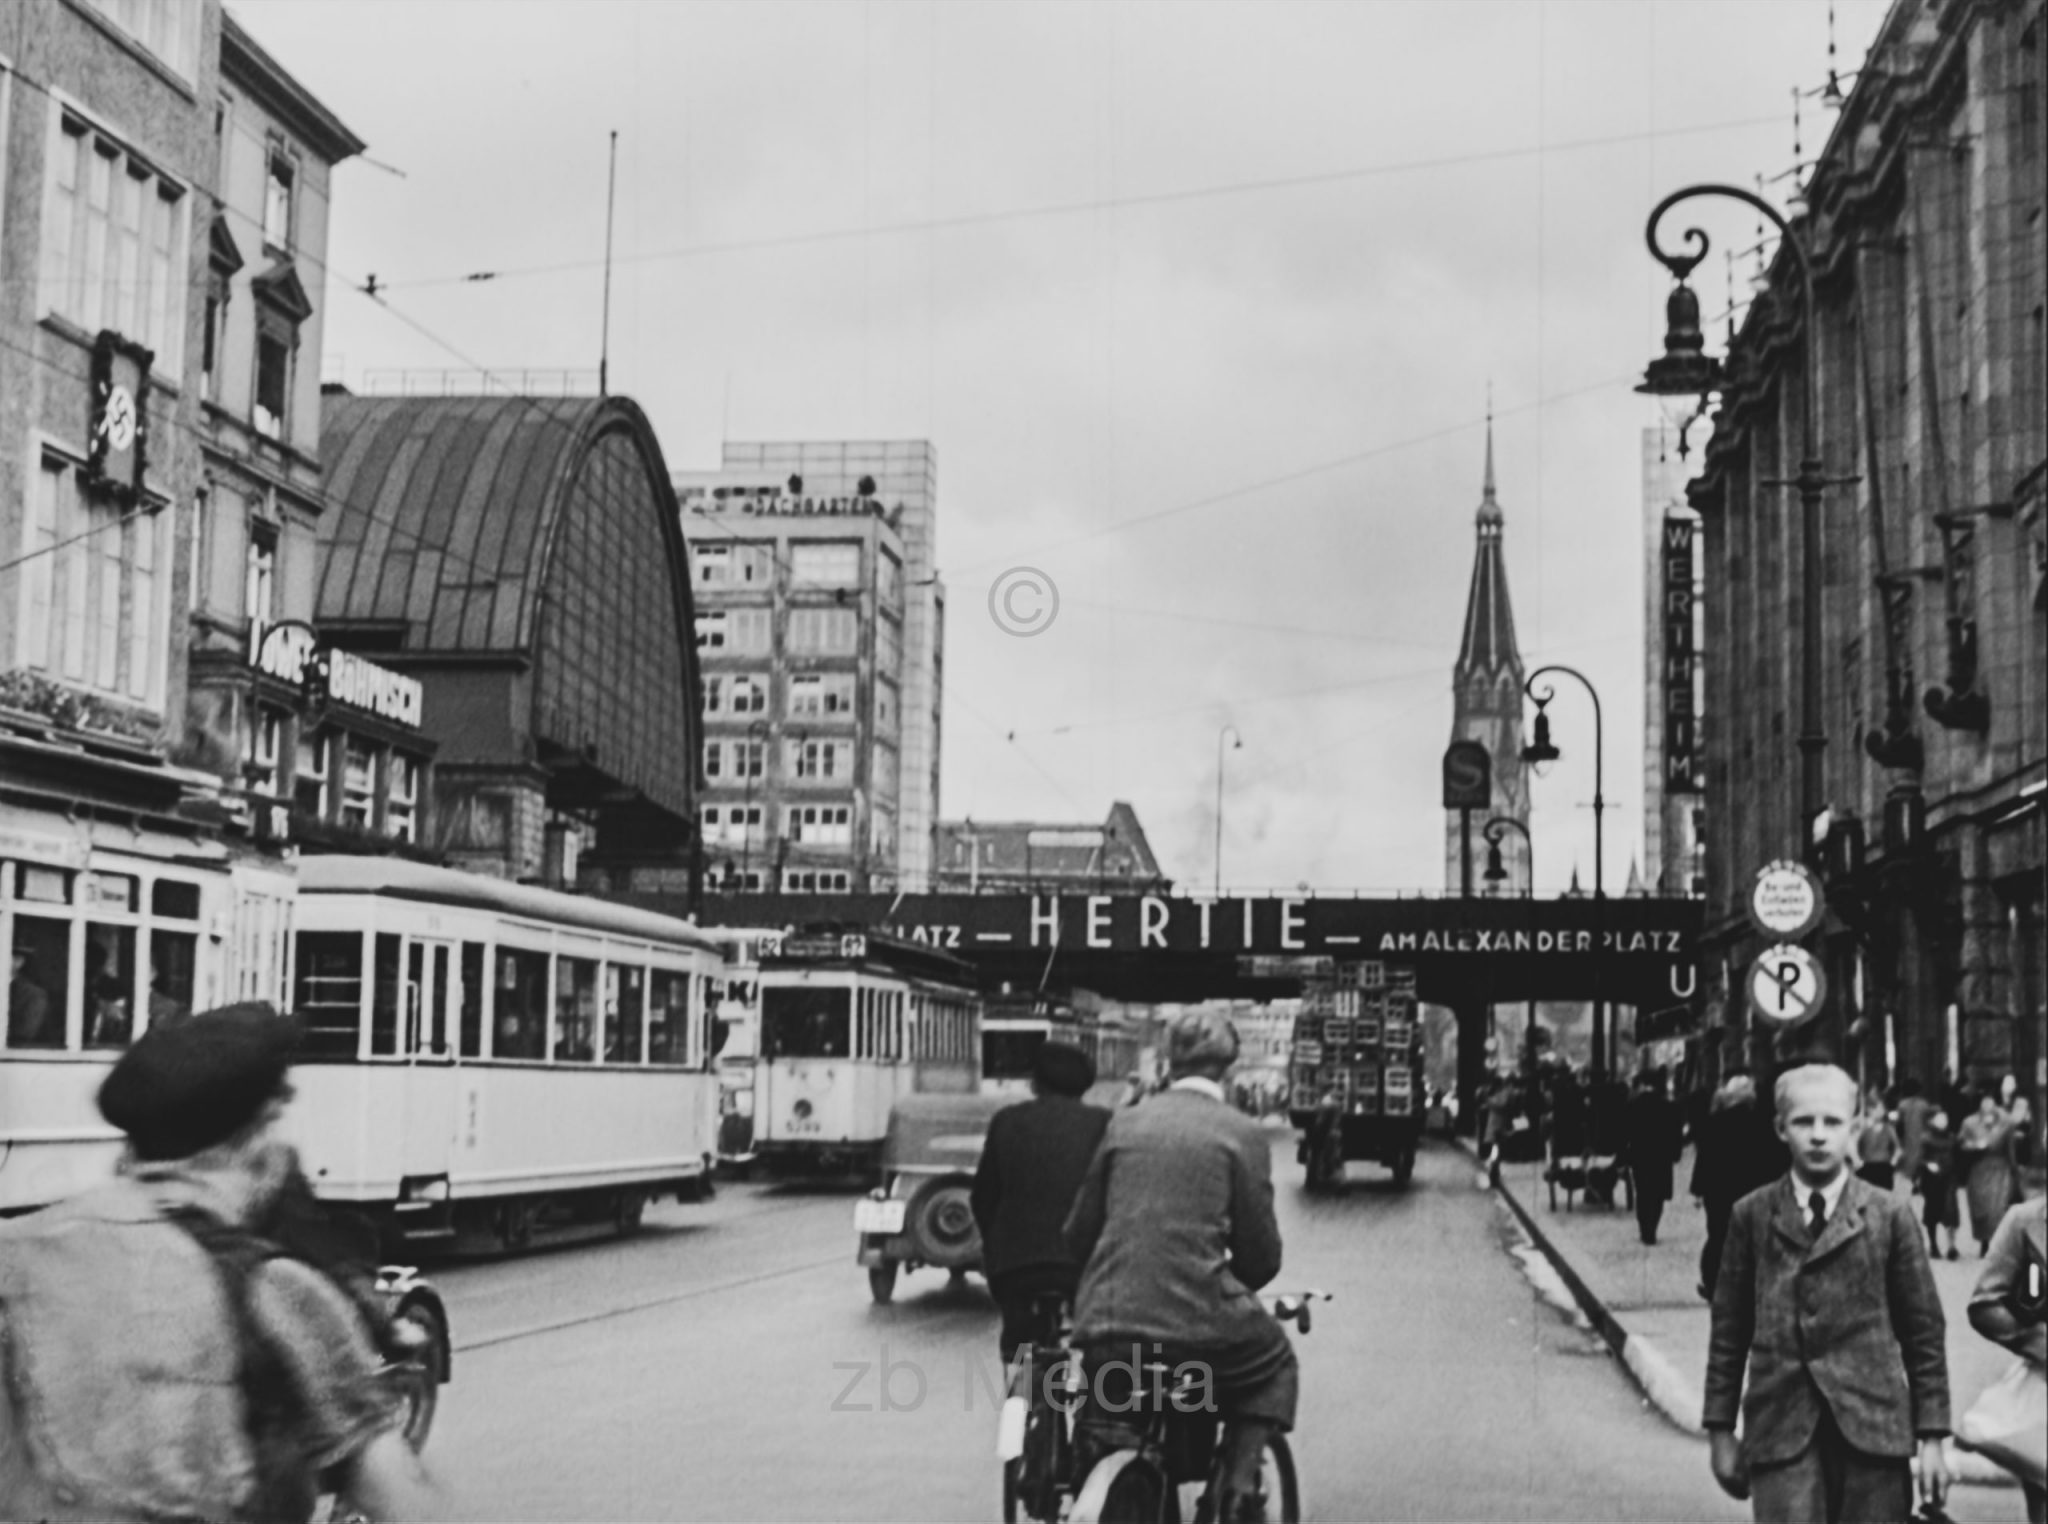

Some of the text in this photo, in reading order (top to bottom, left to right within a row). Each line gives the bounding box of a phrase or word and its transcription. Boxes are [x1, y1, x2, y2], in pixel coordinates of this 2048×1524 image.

[1667, 526, 1692, 780] WERTHEIM
[1448, 748, 1484, 793] S
[1030, 896, 1306, 949] HERTIE
[1670, 963, 1696, 998] U
[1778, 961, 1800, 1011] P
